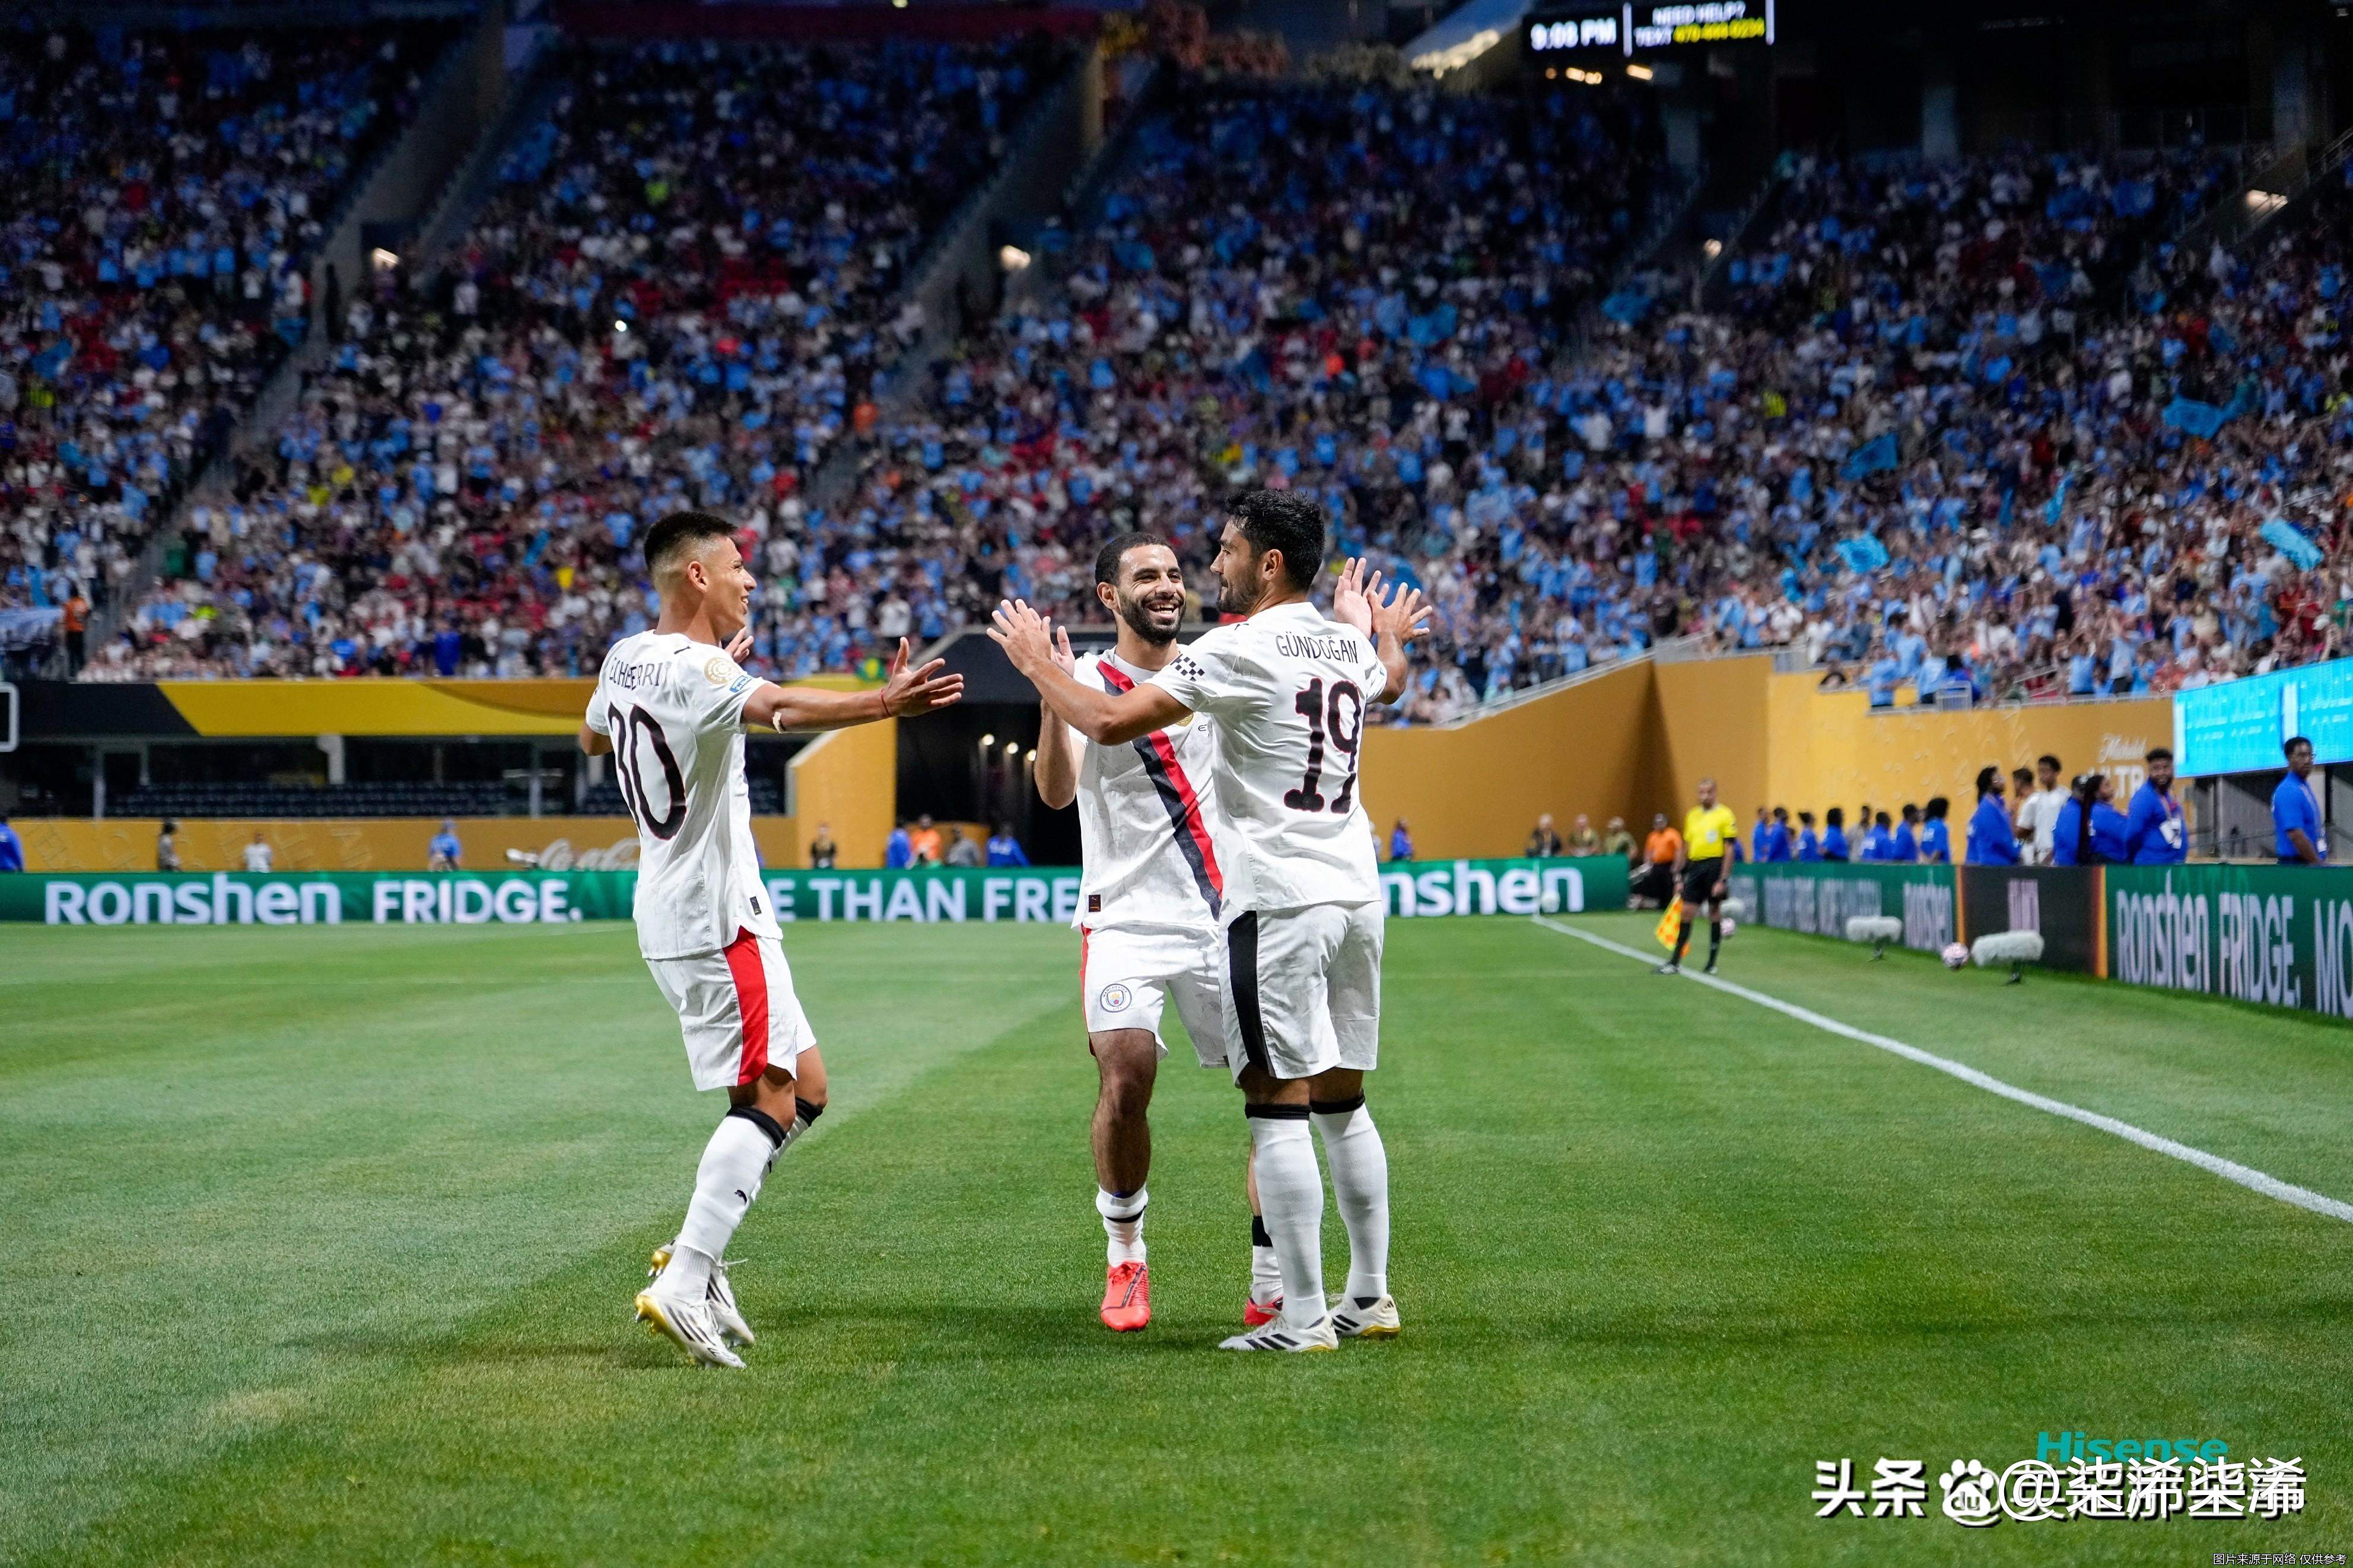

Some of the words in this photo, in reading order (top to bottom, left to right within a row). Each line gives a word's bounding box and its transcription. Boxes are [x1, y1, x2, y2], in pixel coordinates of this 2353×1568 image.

[1581, 17, 1617, 46] PM
[1276, 631, 1359, 664] GÜNDOĞAN
[608, 701, 687, 841] 30
[1284, 678, 1361, 815] 19
[373, 879, 582, 924] FRIDGE.
[809, 878, 966, 923] THAN
[983, 877, 1080, 923] FRE
[1379, 859, 1585, 918] nshen
[2314, 898, 2353, 1019] MO
